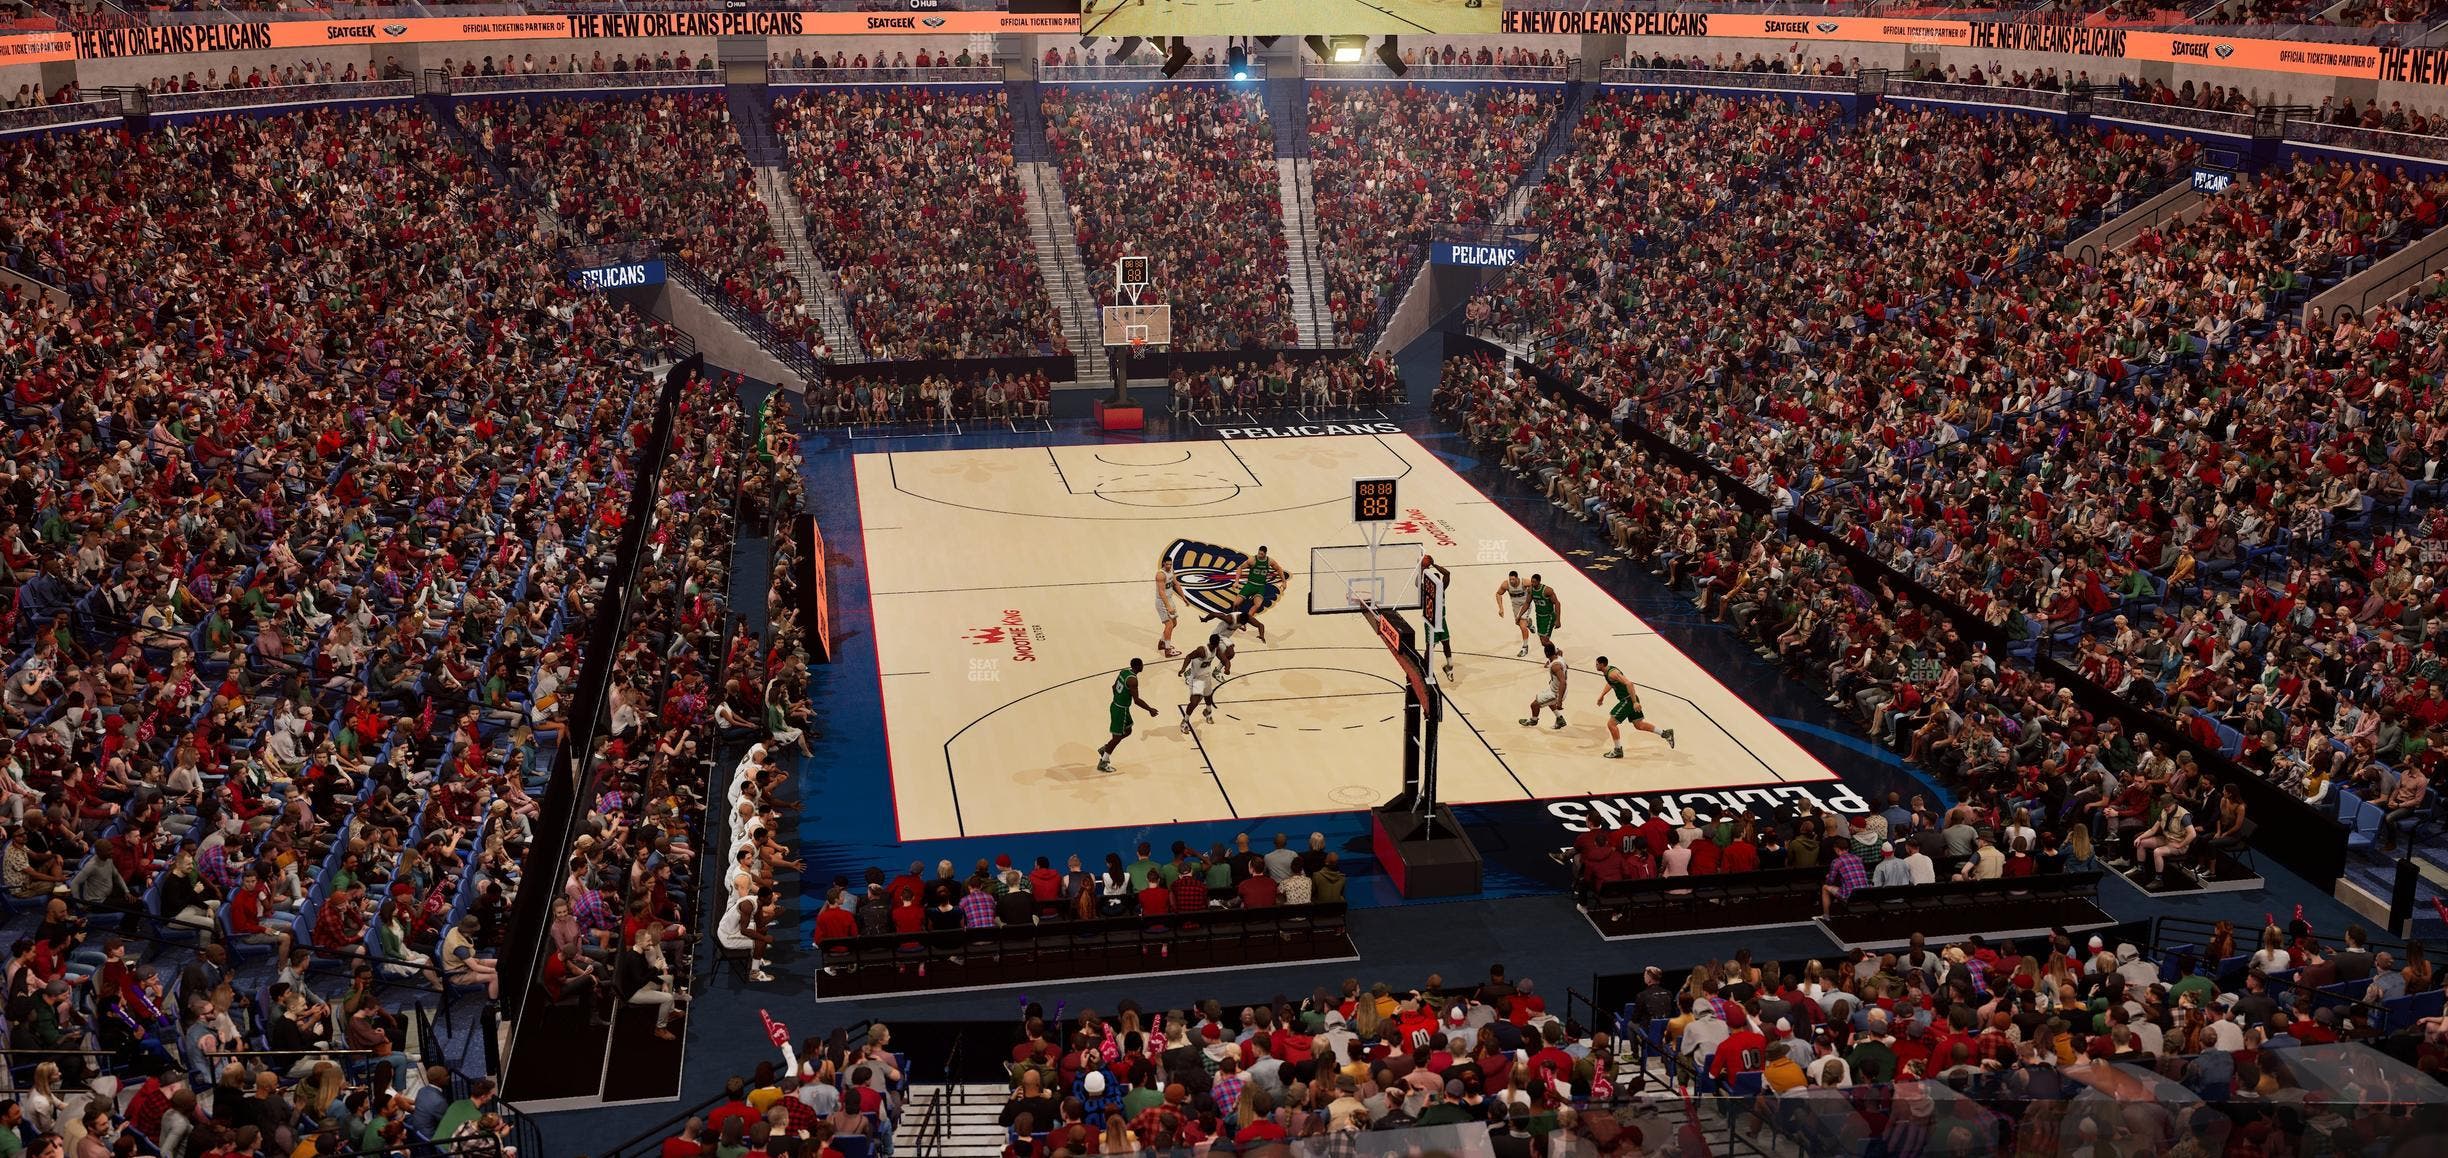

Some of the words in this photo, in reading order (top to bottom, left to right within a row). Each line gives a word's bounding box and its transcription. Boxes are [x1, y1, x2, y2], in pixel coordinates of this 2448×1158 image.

[463, 24, 490, 33] OFFICIAL
[492, 23, 524, 32] TICKETING
[525, 22, 555, 31] PARTNER
[557, 22, 565, 31] OF
[567, 14, 599, 38] THE
[601, 14, 640, 37] NEW
[643, 13, 719, 36] ORLEANS
[722, 12, 803, 35] PELICANS
[867, 17, 915, 29] SEATGEEK
[1001, 18, 1028, 26] OFFICIAL
[1030, 18, 1062, 26] TICKETING
[1521, 12, 1556, 33] NEW
[1559, 12, 1631, 35] ORLEANS
[1635, 12, 1708, 36] PELICANS
[1765, 20, 1810, 34] SEATGEEK
[71, 30, 98, 59] THE
[98, 28, 126, 58] NEW
[129, 25, 193, 55] ORLEANS
[196, 22, 271, 50] PELICANS
[327, 25, 377, 39] SEATGEEK
[1883, 26, 1906, 36] OFFICIAL
[1935, 27, 1958, 38] PARTNER
[1960, 28, 1967, 38] OF
[1969, 22, 1995, 48] THE
[1998, 23, 2021, 49] NEW
[2023, 25, 2071, 54] ORLEANS
[2073, 28, 2126, 58] PELICANS
[2172, 40, 2209, 58] SEATGEEK
[2279, 50, 2305, 63] OFFICIAL
[2307, 52, 2337, 66] TICKETING
[2338, 54, 2365, 68] PARTNER
[2367, 57, 2376, 68] OF
[2378, 47, 2409, 81] THE
[2410, 50, 2448, 86] NEW
[1452, 246, 1515, 266] PELICANS
[1217, 422, 1401, 439] PELICANS
[1364, 497, 1388, 516] 88
[1742, 1049, 1760, 1069] 00
